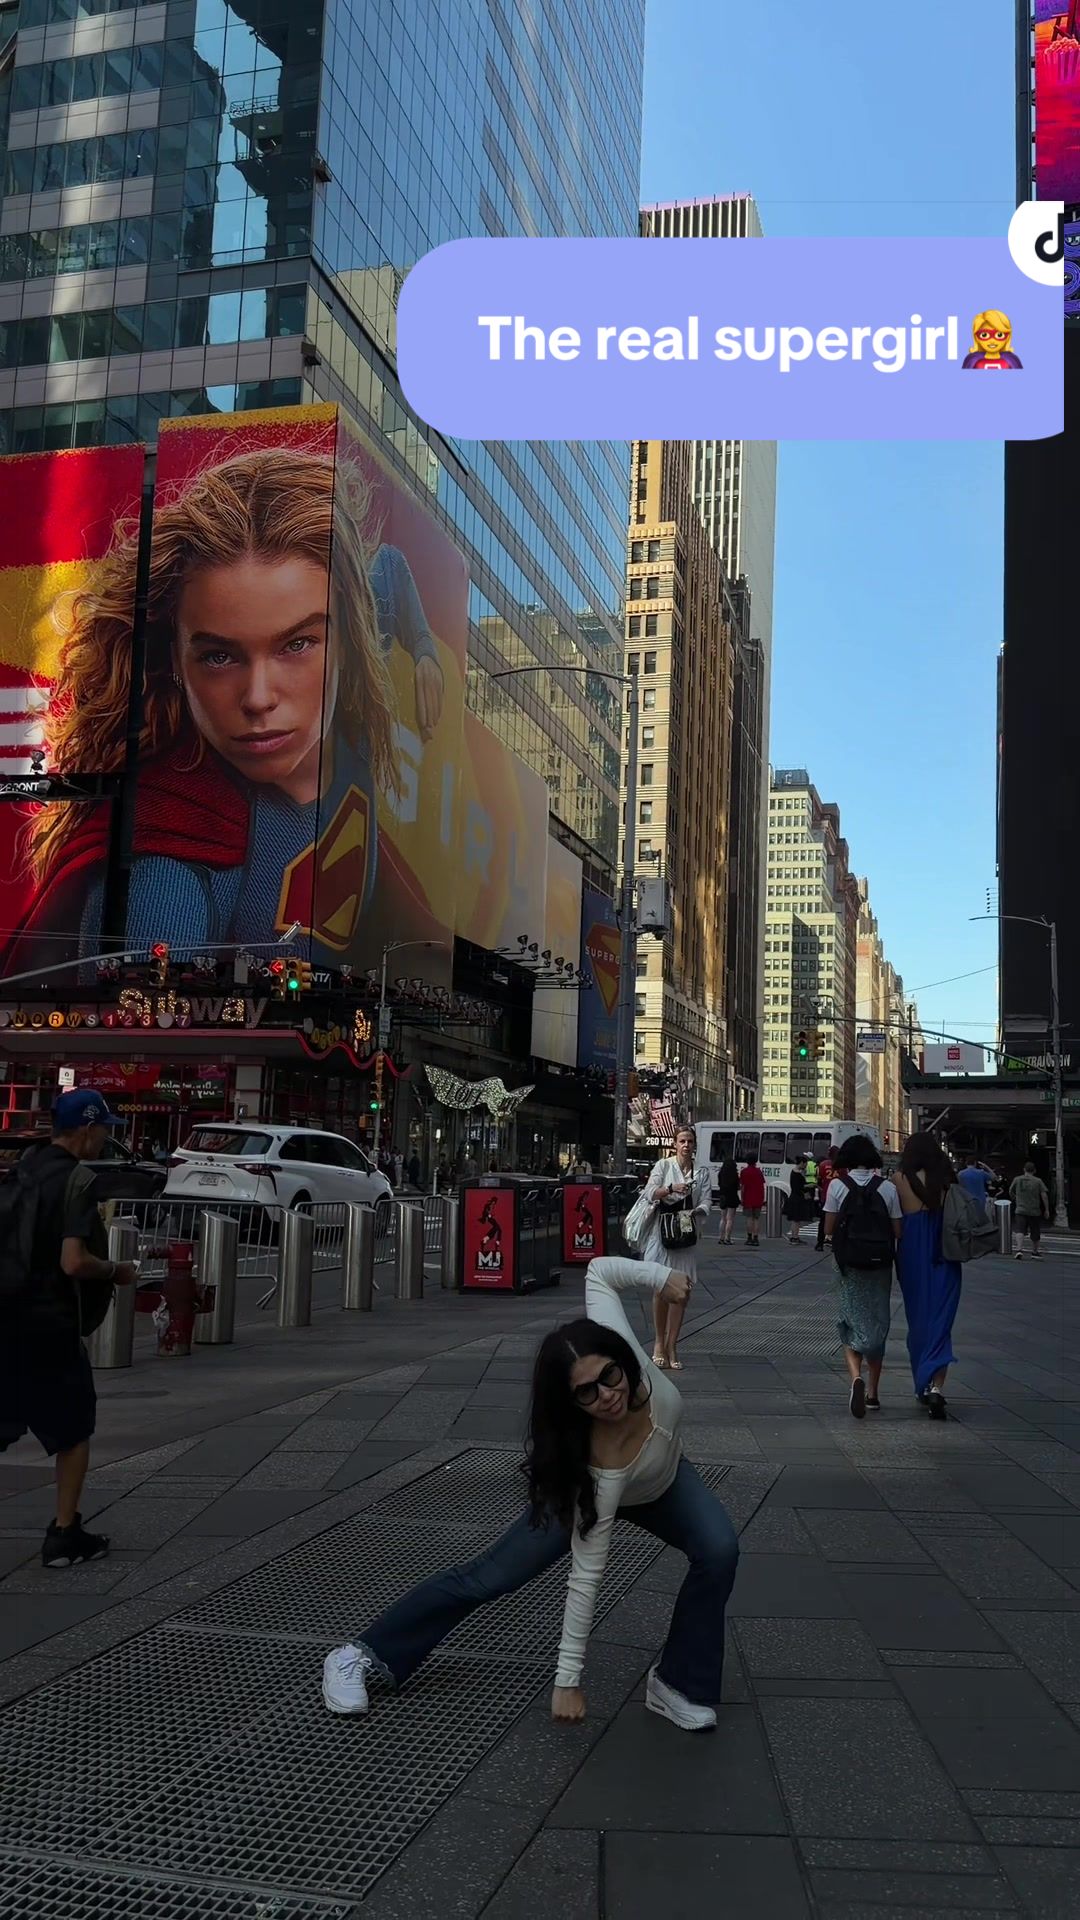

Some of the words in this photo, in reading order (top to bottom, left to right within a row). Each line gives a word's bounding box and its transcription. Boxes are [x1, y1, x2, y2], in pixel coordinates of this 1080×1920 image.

[119, 988, 271, 1028] Subway
[645, 1137, 659, 1146] 260
[574, 1233, 593, 1247] MJ
[478, 1251, 501, 1267] MJ
